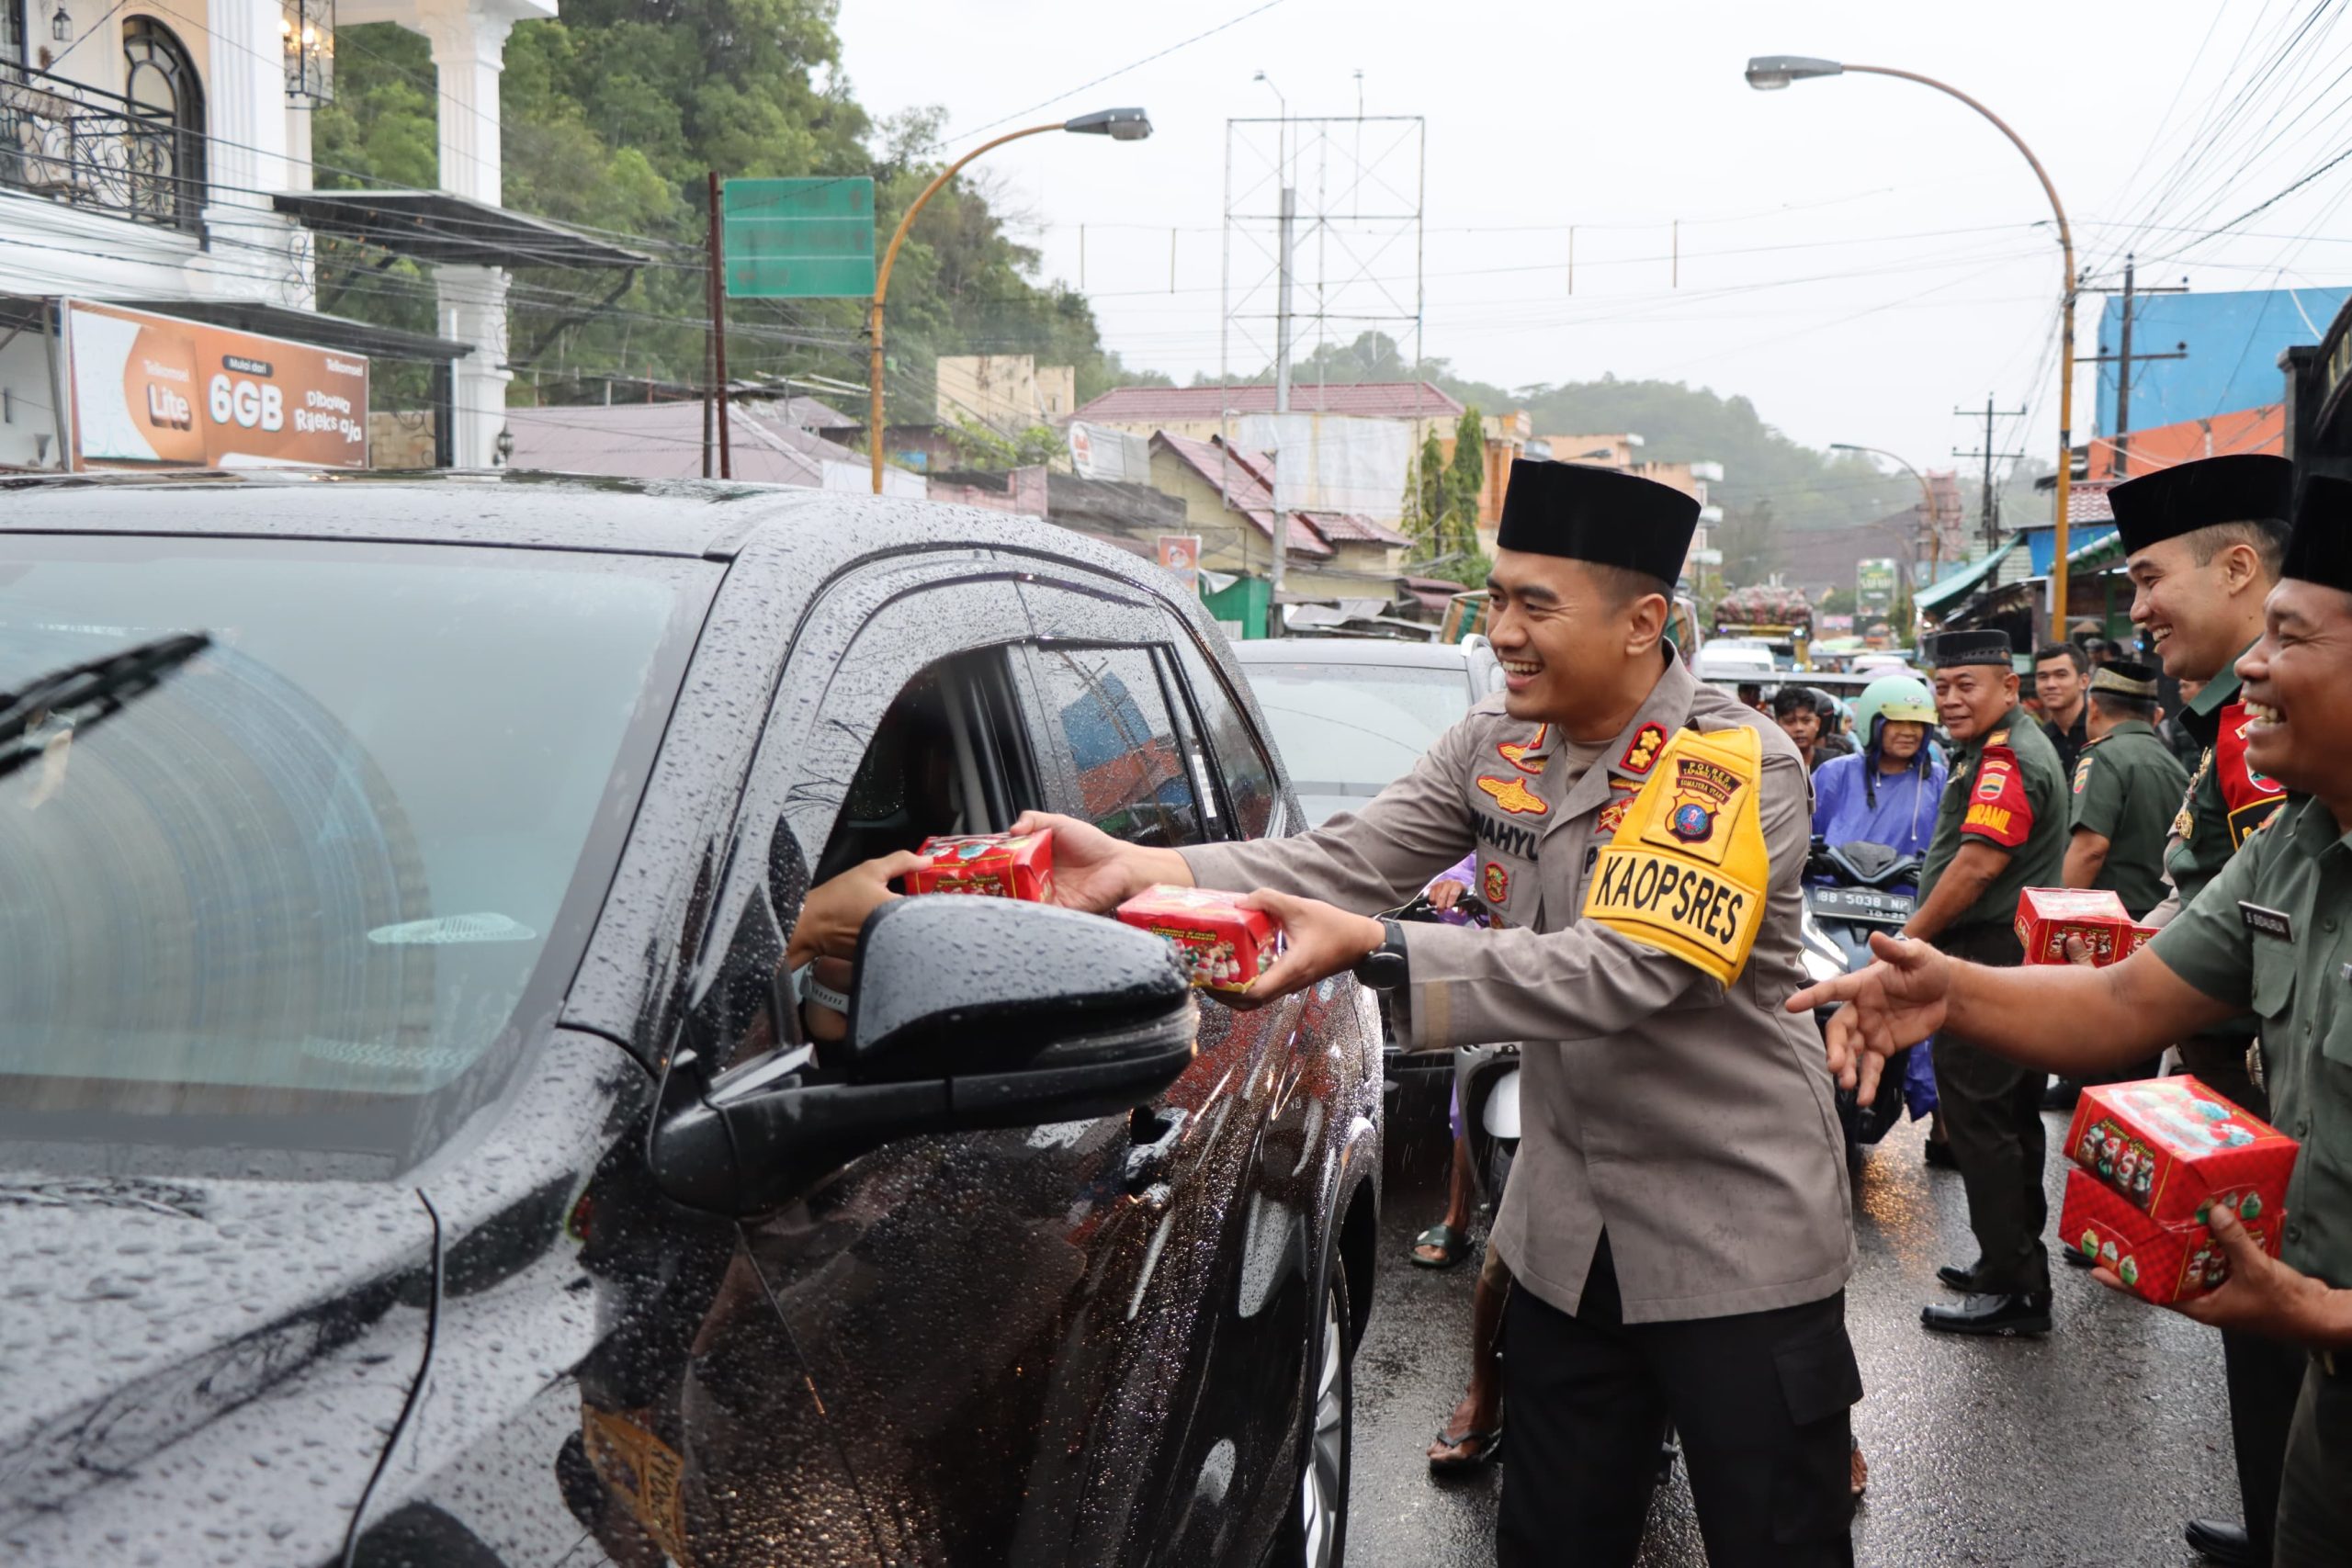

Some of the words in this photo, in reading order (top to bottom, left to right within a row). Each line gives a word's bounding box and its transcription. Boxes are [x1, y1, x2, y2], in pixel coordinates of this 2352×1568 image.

[148, 382, 191, 427] Lite
[209, 374, 284, 432] 6GB
[306, 390, 351, 414] Dibawa
[339, 419, 362, 444] aja
[1689, 761, 1732, 783] POLRES
[1594, 856, 1744, 945] KAOPSRES
[1819, 891, 1838, 903] BB
[1845, 893, 1882, 908] 5038
[1891, 898, 1908, 910] NP
